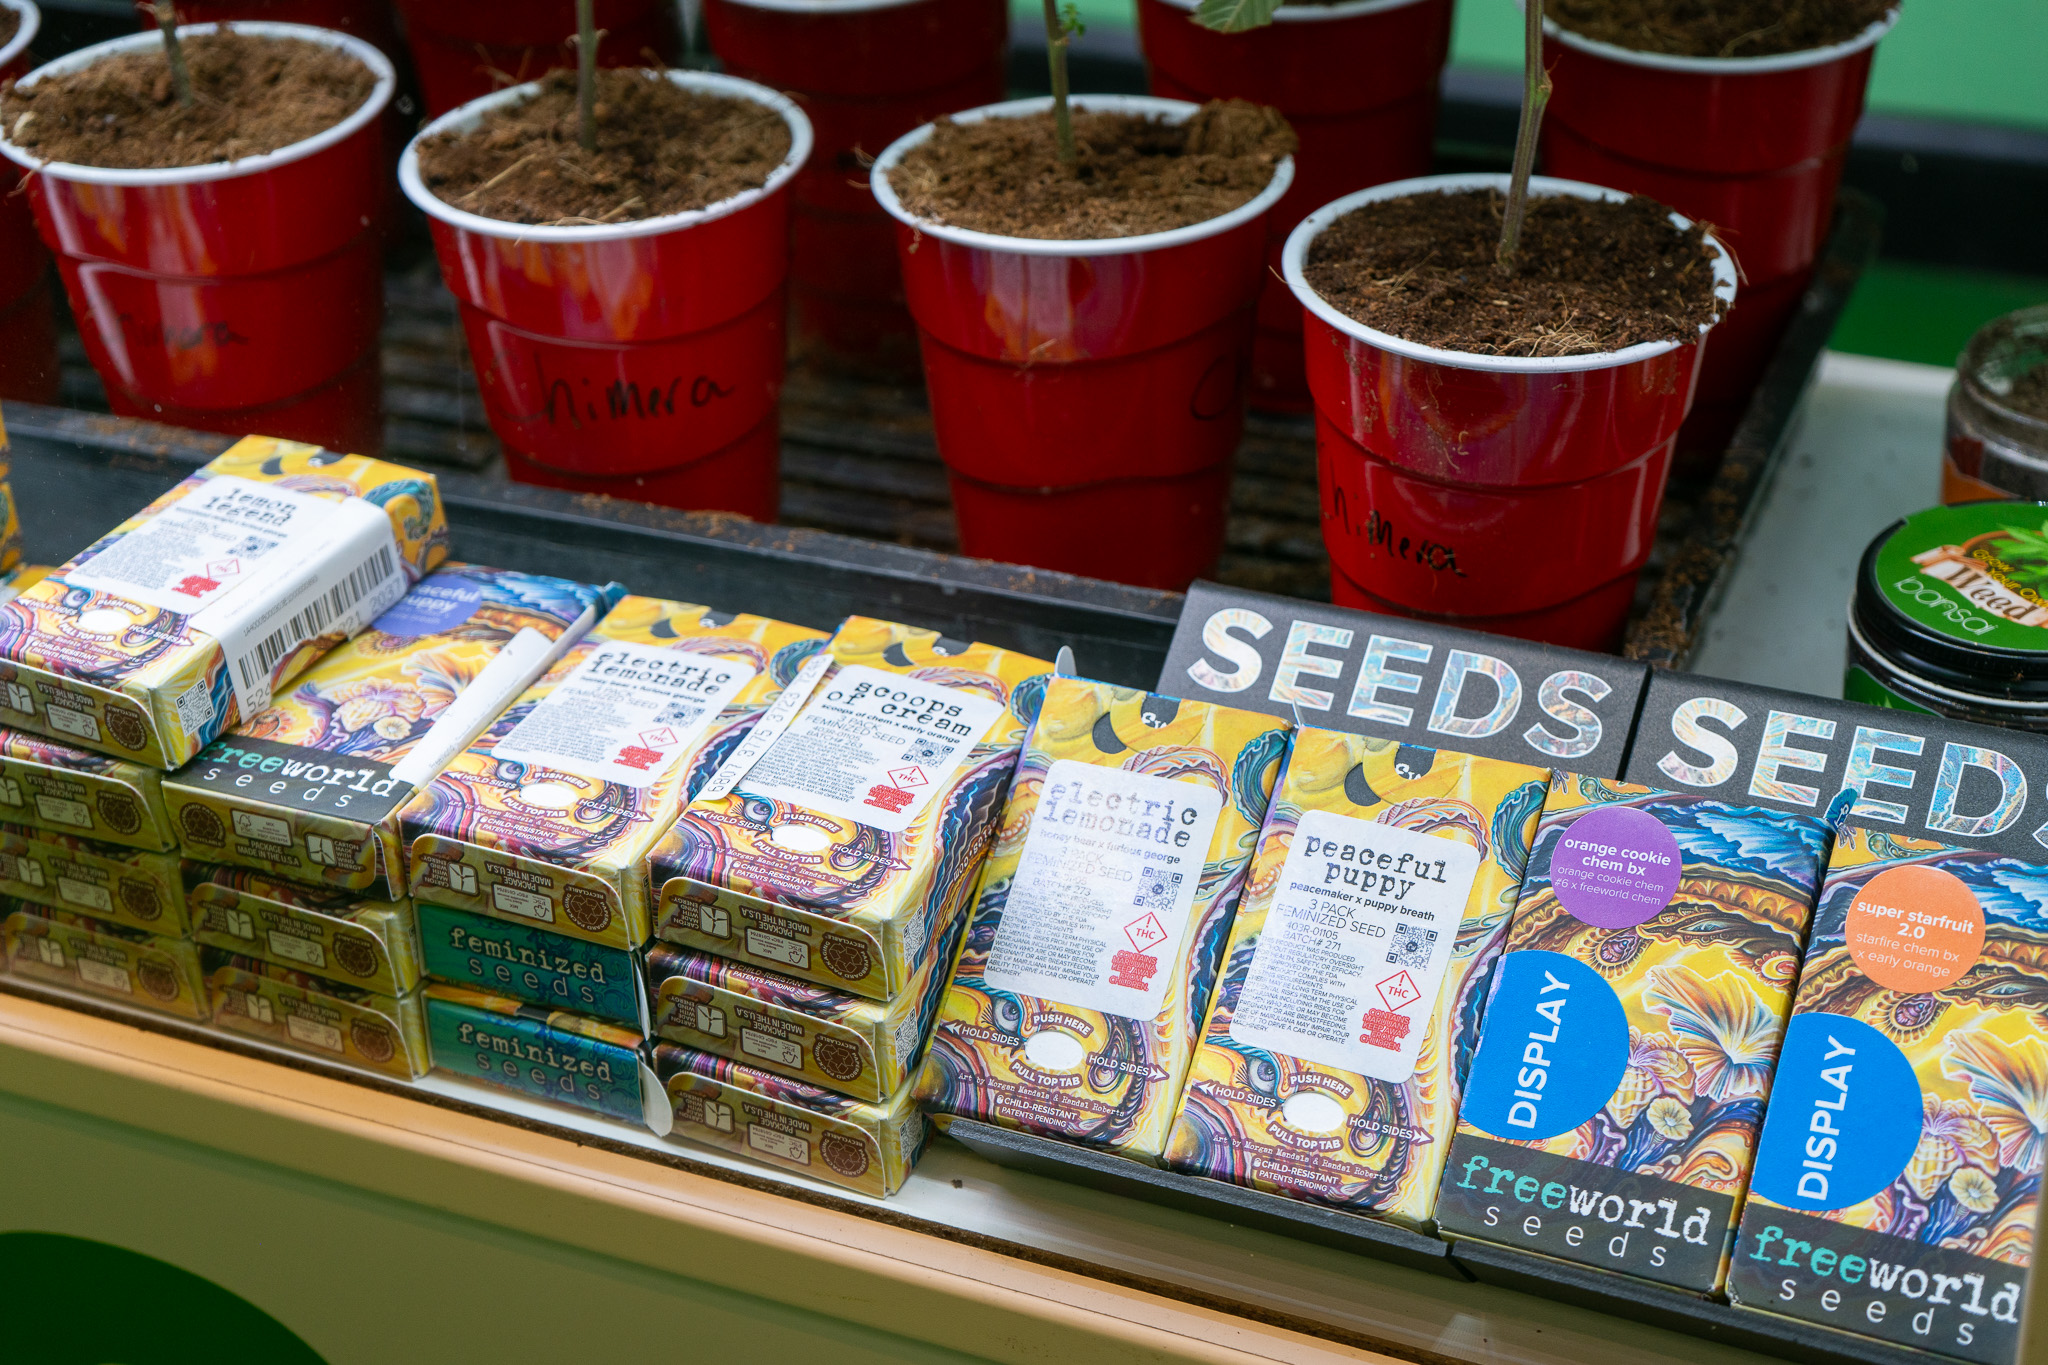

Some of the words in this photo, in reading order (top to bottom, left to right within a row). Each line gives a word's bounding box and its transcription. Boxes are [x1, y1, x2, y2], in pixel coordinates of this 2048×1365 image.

[202, 498, 293, 527] legend
[224, 488, 298, 513] lemon
[418, 584, 481, 603] aceful
[1945, 565, 2040, 620] Weed
[408, 596, 458, 614] uppy
[1893, 576, 1997, 635] bonsai
[59, 622, 77, 638] PULL
[76, 629, 98, 641] TOP
[95, 634, 116, 642] TAB
[129, 625, 155, 637] HOLD
[152, 630, 179, 644] SIDES
[588, 661, 720, 695] lemonade
[599, 652, 731, 684] electric
[1186, 607, 1614, 759] SEEDS
[854, 682, 963, 717] scoops
[822, 704, 854, 717] scoops
[854, 711, 866, 720] of
[866, 712, 893, 727] chem
[902, 722, 926, 736] early
[926, 730, 961, 744] orange
[827, 690, 866, 707] of
[881, 703, 972, 737] cream
[848, 717, 879, 732] PACK
[805, 715, 868, 736] FEMINIZED
[866, 729, 906, 746] SEED
[197, 741, 400, 798] freeworld
[535, 771, 562, 782] PUSH
[562, 774, 588, 789] HERE
[898, 773, 918, 783] THC
[1655, 697, 2048, 850] SEED
[204, 767, 352, 808] seeds
[462, 774, 490, 787] HOLD
[488, 778, 517, 790] SIDES
[503, 797, 528, 814] PULL
[526, 805, 548, 817] TOP
[546, 809, 567, 818] TAB
[578, 799, 608, 814] HOLD
[605, 804, 635, 819] SIDES
[1051, 781, 1198, 826] electric
[483, 823, 514, 837] PATENTS
[512, 829, 544, 842] PENDING
[487, 817, 556, 839] CHILD-RESISTANT
[708, 814, 737, 826] HOLD
[738, 819, 768, 831] SIDES
[784, 813, 814, 824] PUSH
[813, 816, 840, 833] HERE
[1044, 800, 1191, 847] lemonade
[754, 841, 779, 858] PULL
[778, 850, 800, 862] TOP
[799, 855, 822, 863] TAB
[832, 844, 860, 858] HOLD
[861, 851, 892, 866] SIDES
[1144, 849, 1180, 864] george
[1304, 835, 1446, 884] peaceful
[1564, 836, 1618, 858] orange
[1621, 846, 1671, 866] cookie
[741, 863, 813, 887] CHILD-RESISTANT
[1582, 855, 1624, 873] chem
[1627, 862, 1647, 877] bx
[736, 870, 769, 883] PATENTS
[769, 877, 800, 892] PENDING
[1324, 861, 1415, 901] puppy
[1557, 866, 1595, 882] orange
[1597, 872, 1632, 887] cookie
[1634, 879, 1664, 892] chem
[1290, 881, 1354, 903] peacemaker
[1364, 898, 1404, 914] puppy
[1400, 904, 1435, 921] breath
[1554, 878, 1568, 888] #6
[1571, 882, 1578, 890] x
[1580, 881, 1629, 900] freeworld
[1632, 892, 1661, 906] chem
[761, 913, 777, 926] THE
[1276, 904, 1347, 931] FEMINIZED
[1350, 921, 1386, 938] SEED
[1309, 899, 1318, 910] 3
[1321, 902, 1356, 919] PACK
[1857, 898, 1905, 922] super
[1906, 910, 1975, 935] starfruit
[758, 920, 793, 937] PACKAGE
[786, 919, 810, 933] MADE
[1136, 928, 1155, 940] THC
[1896, 922, 1926, 940] 2.0
[828, 934, 865, 949] RECYCLABLE
[1283, 931, 1323, 948] BATCH#
[1326, 942, 1341, 951] 271
[1855, 931, 1900, 952] starfire
[1902, 942, 1940, 959] chem
[1942, 948, 1960, 963] bx
[450, 927, 607, 984] feminized
[1857, 950, 1865, 959] x
[1867, 950, 1901, 968] early
[1903, 958, 1951, 979] orange
[469, 957, 595, 1003] seeds
[732, 970, 766, 986] PATENTS
[764, 977, 796, 993] PENDING
[1388, 986, 1409, 999] THC
[962, 1027, 989, 1040] HOLD
[991, 1032, 1020, 1046] SIDES
[1033, 1015, 1062, 1025] PUSH
[1064, 1018, 1091, 1036] HERE
[457, 1023, 613, 1083] feminized
[1506, 970, 1571, 1129] DISPLAY
[477, 1052, 601, 1100] seeds
[738, 1066, 772, 1081] PATENTS
[770, 1072, 801, 1089] PENDING
[1012, 1062, 1037, 1082] PULL
[1037, 1074, 1059, 1086] TOP
[1059, 1077, 1080, 1087] TAB
[1089, 1055, 1118, 1069] HOLD
[1120, 1062, 1149, 1076] SIDES
[1216, 1086, 1245, 1102] HOLD
[1246, 1093, 1277, 1108] SIDES
[1290, 1075, 1321, 1086] PUSH
[1322, 1077, 1351, 1098] HERE
[1002, 1107, 1033, 1120] PATENTS
[1034, 1114, 1066, 1128] PENDING
[1004, 1097, 1078, 1121] CHILD-RESISTANT
[1797, 1034, 1857, 1201] DISPLAY
[1269, 1124, 1295, 1145] PULL
[1296, 1136, 1319, 1149] TOP
[1318, 1139, 1341, 1150] TAB
[1349, 1117, 1380, 1133] HOLD
[1381, 1123, 1413, 1140] SIDES
[1213, 1133, 1228, 1144] Art
[1232, 1139, 1241, 1148] by
[1244, 1140, 1273, 1156] Morgan
[1355, 1166, 1388, 1181] Roberts
[1258, 1170, 1293, 1184] PATENTS
[1294, 1178, 1327, 1193] PENDING
[1261, 1160, 1339, 1185] CHILD-RESISTANT
[1457, 1155, 1711, 1246] freeworld
[1484, 1205, 1667, 1268] seeds
[1748, 1224, 2022, 1324] freeworld
[1778, 1278, 1975, 1346] seeds
